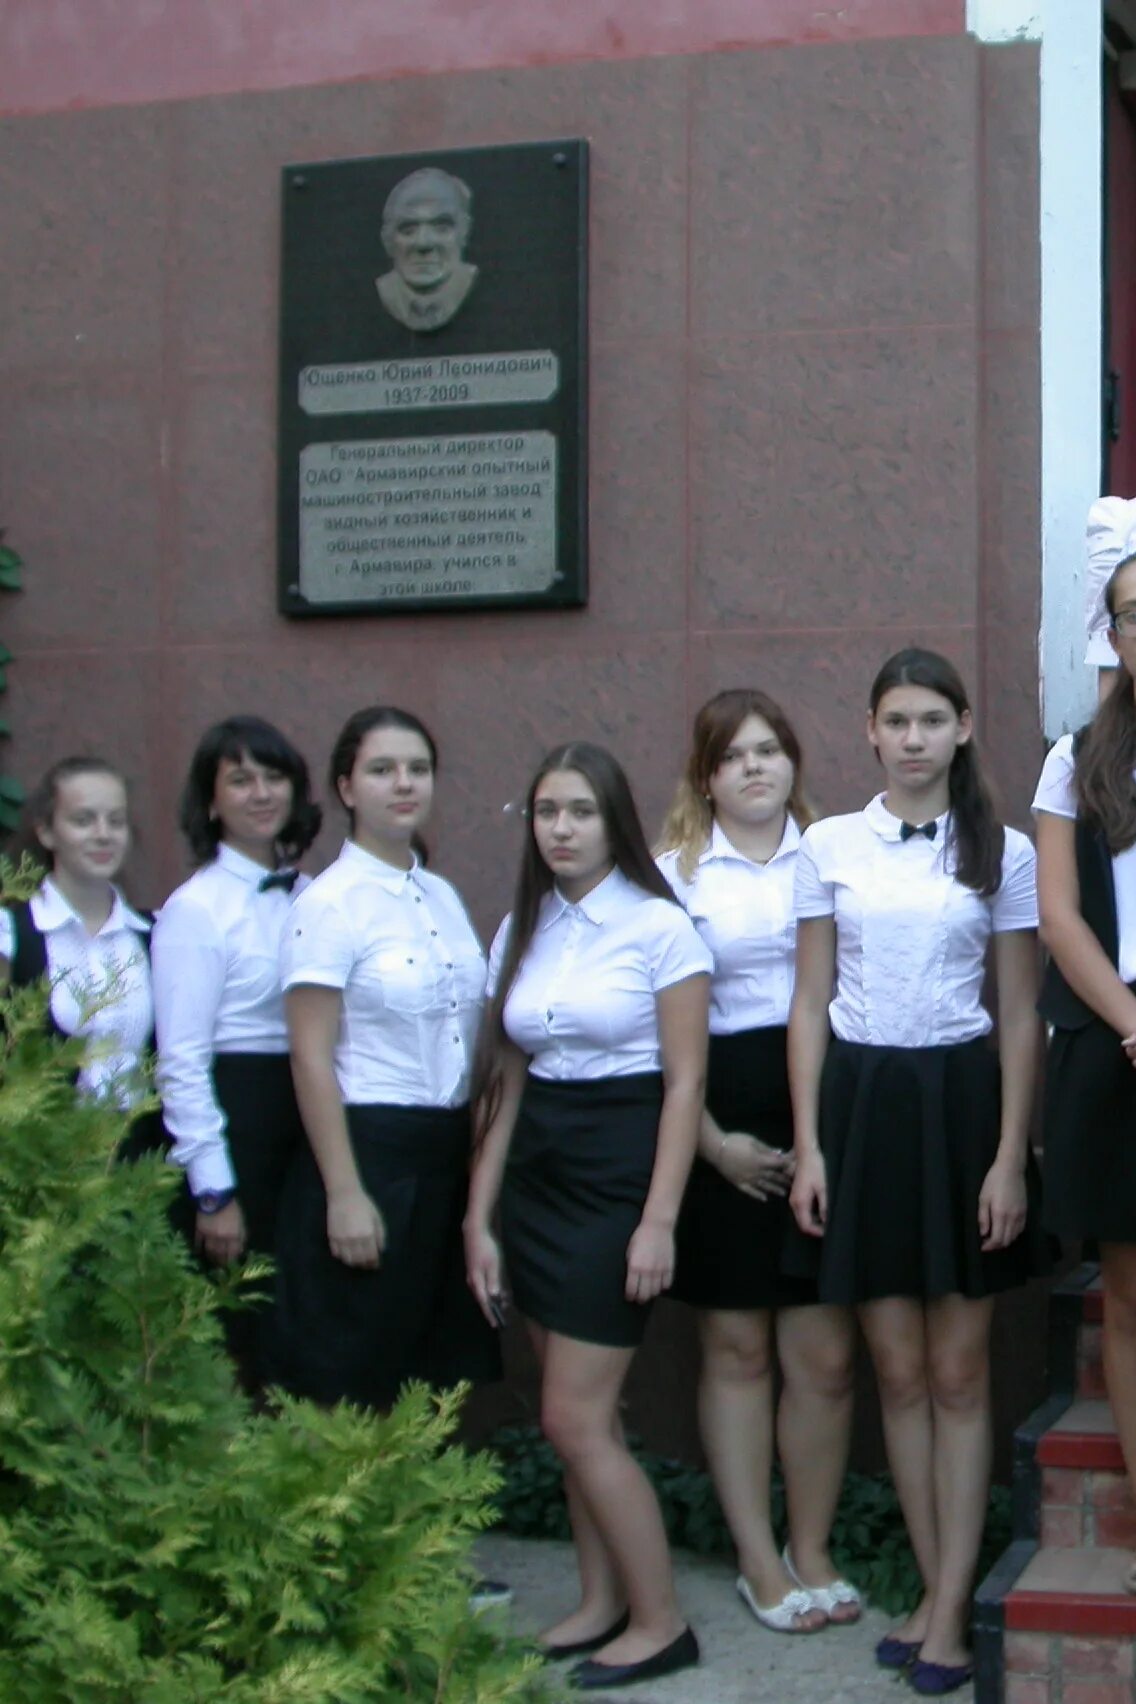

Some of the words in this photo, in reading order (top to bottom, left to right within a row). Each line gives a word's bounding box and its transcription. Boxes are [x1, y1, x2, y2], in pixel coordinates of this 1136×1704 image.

[382, 360, 433, 382] Юрий
[439, 357, 553, 377] Леонидович
[384, 383, 470, 405] 1937-2009
[330, 441, 441, 460] Генеральный
[444, 437, 525, 456] директор
[305, 467, 342, 485] ОАО
[471, 458, 551, 476] опытный
[300, 483, 487, 507] машиностроительный
[393, 507, 517, 526] хозяйственник
